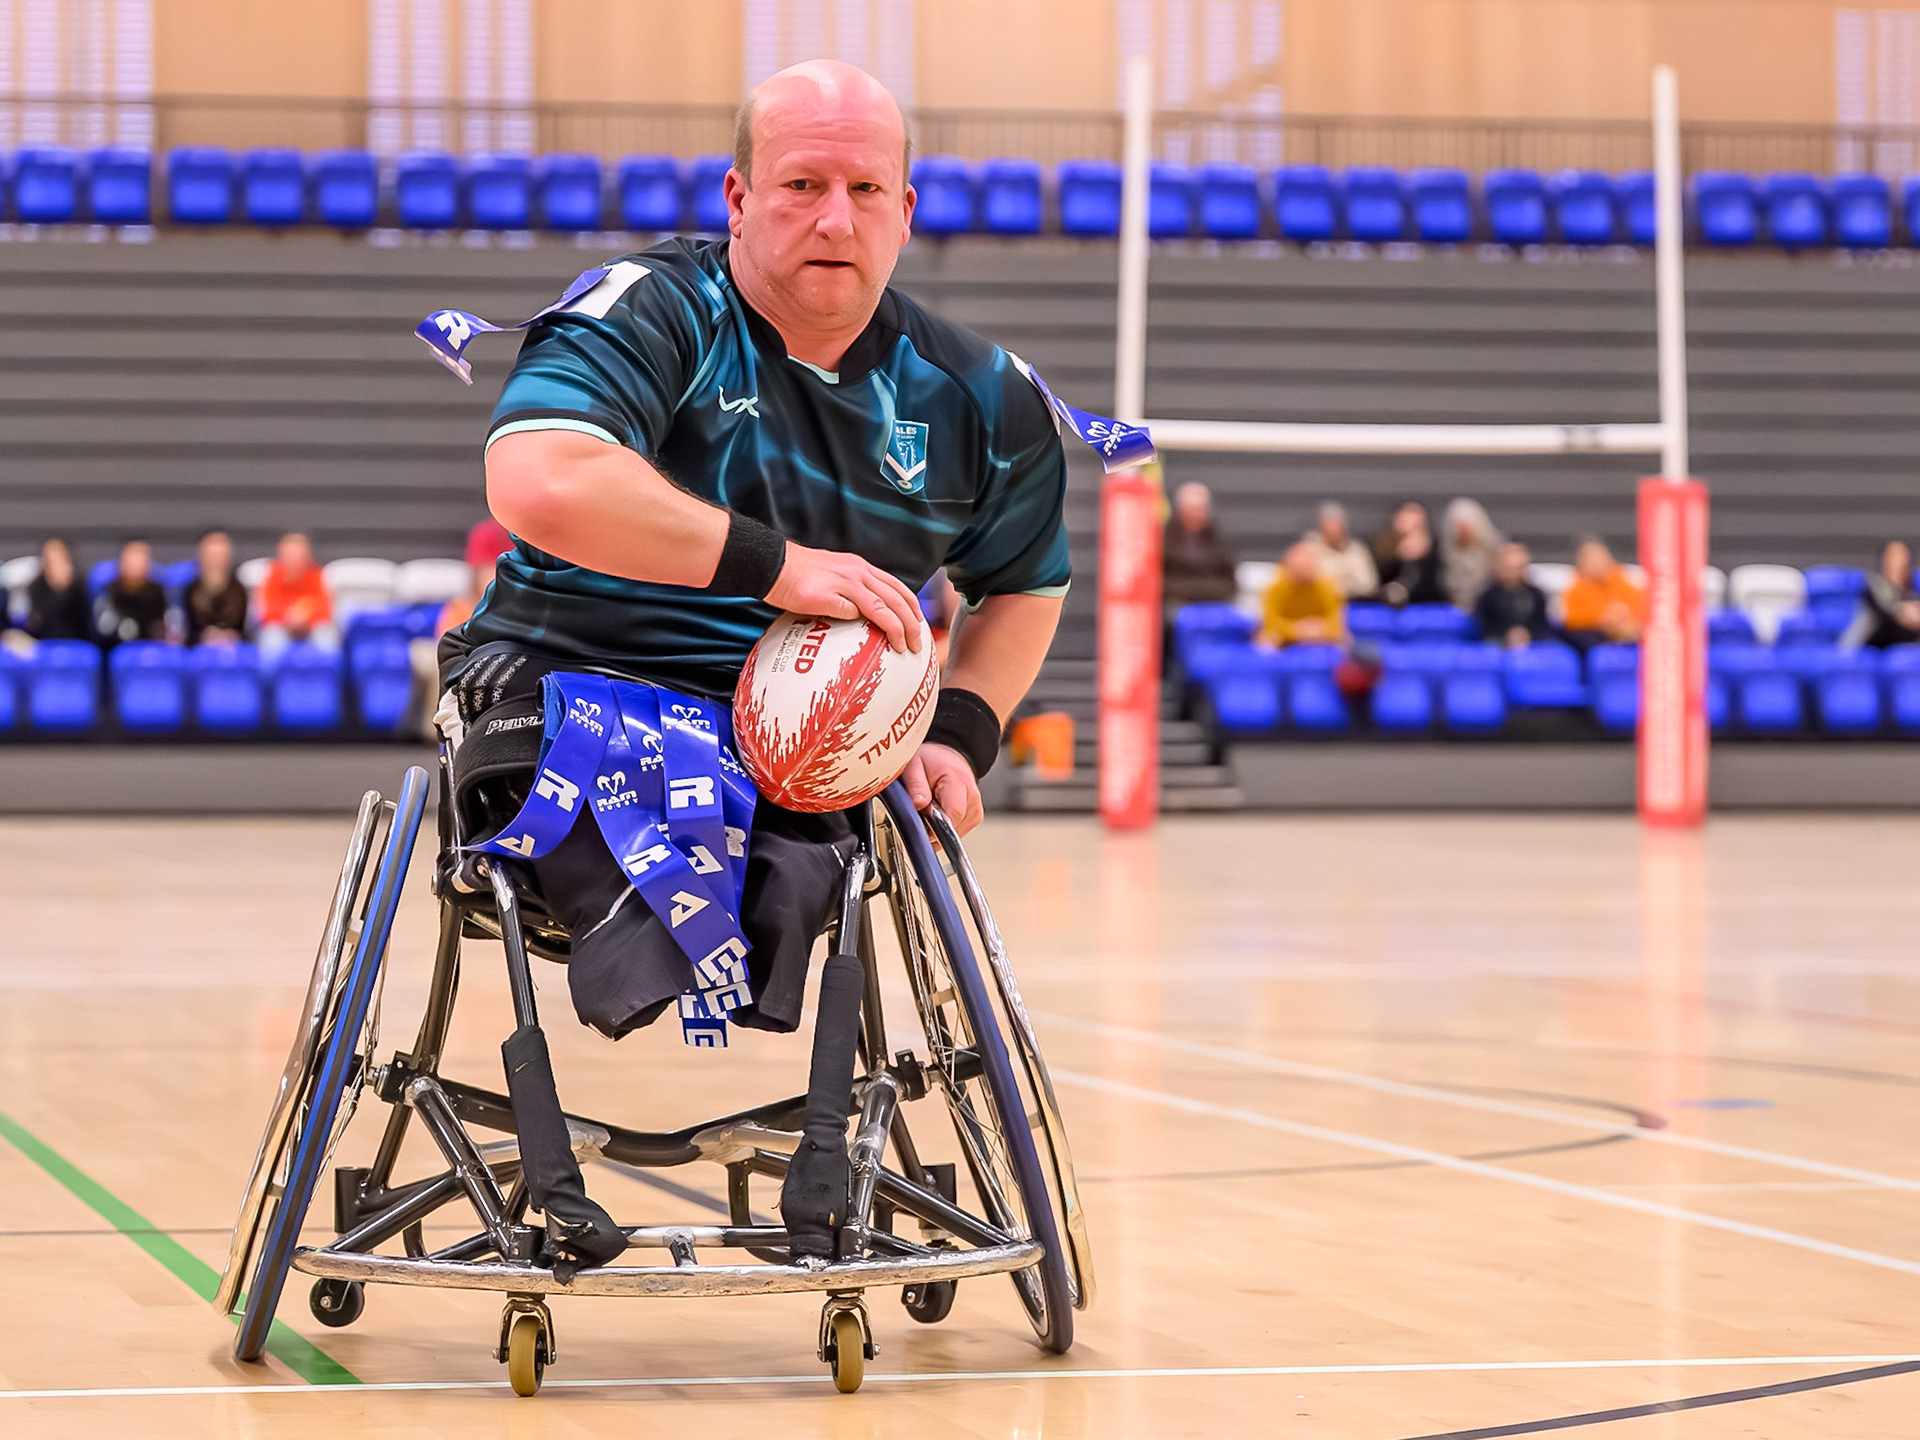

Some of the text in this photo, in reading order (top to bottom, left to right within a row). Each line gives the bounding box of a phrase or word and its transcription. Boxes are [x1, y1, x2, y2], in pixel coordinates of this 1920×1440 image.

[794, 617, 831, 674] ATED
[771, 657, 782, 673] 2021
[570, 707, 604, 733] RAM
[596, 790, 638, 808] RAM
[669, 776, 715, 809] R
